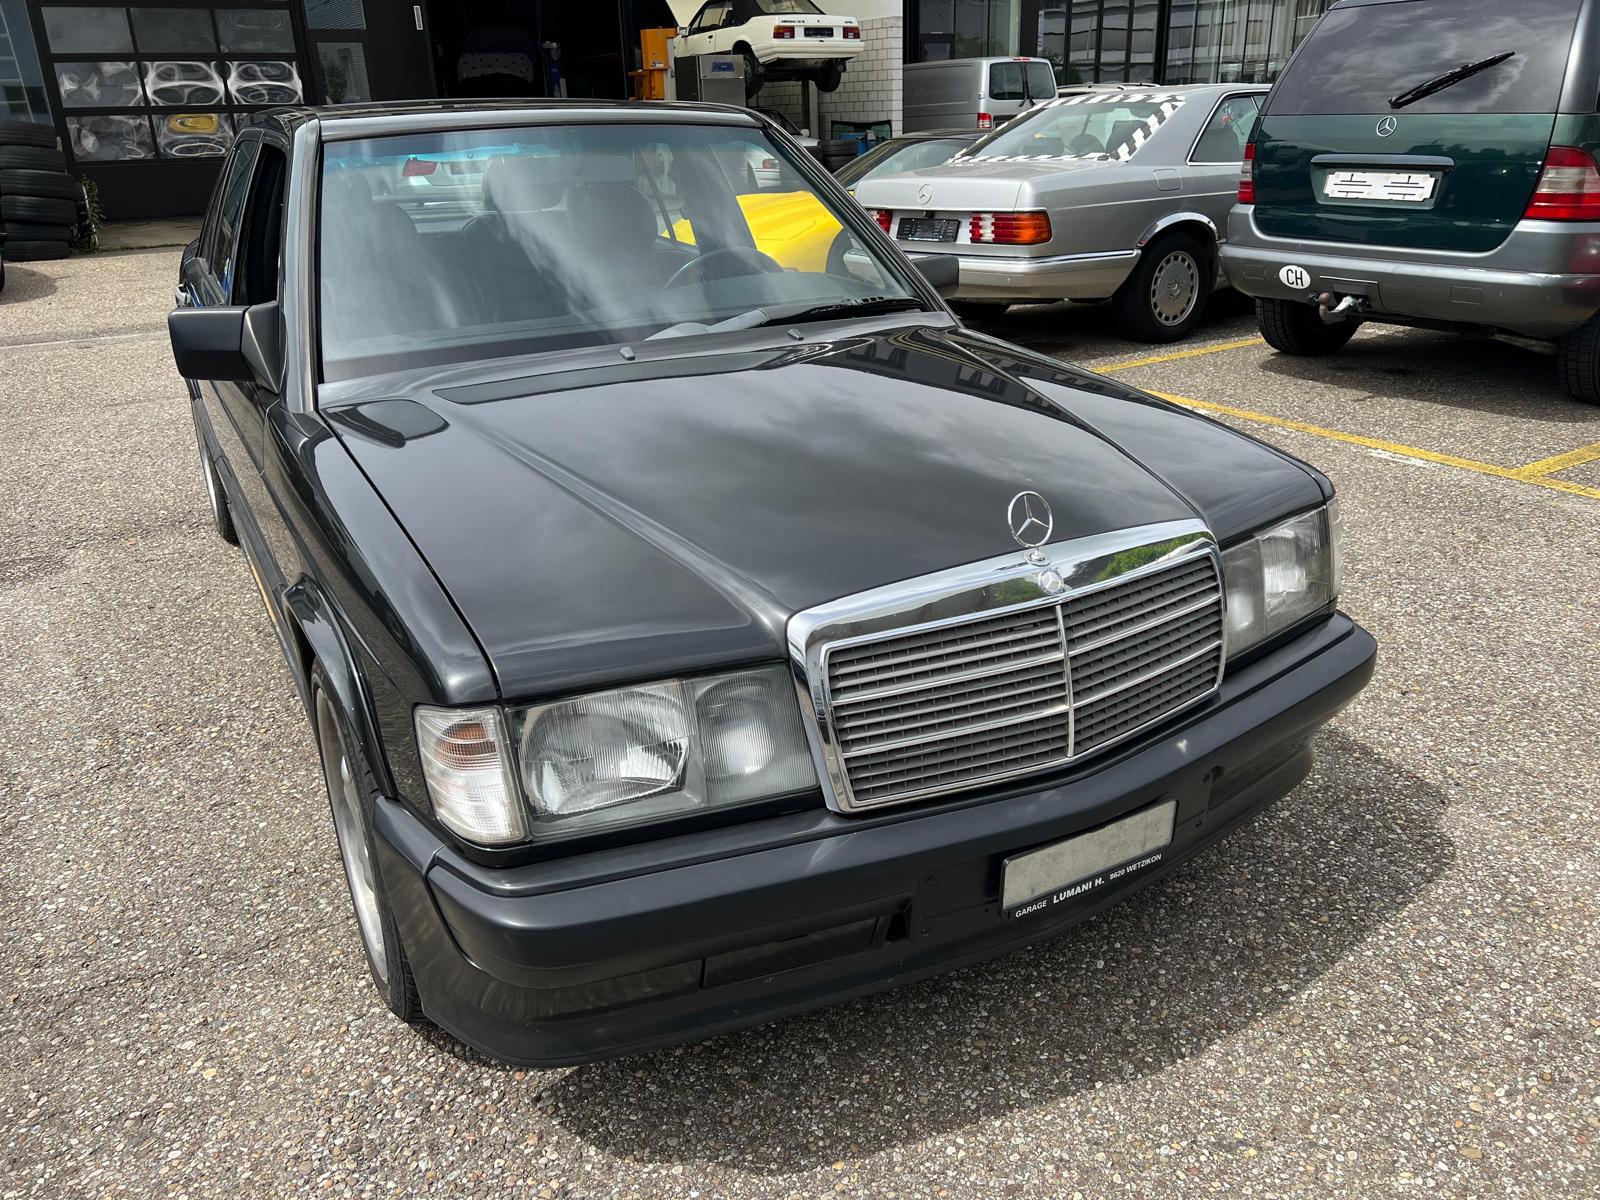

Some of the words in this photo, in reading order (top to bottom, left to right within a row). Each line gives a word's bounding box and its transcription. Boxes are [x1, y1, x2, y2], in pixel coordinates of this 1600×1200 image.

[1286, 268, 1304, 287] CH
[1015, 899, 1048, 918] GARAGE
[1052, 881, 1092, 904] LUMANI
[1094, 877, 1105, 887] H.
[1109, 869, 1126, 880] 8620
[1126, 853, 1162, 873] WETZIKON
